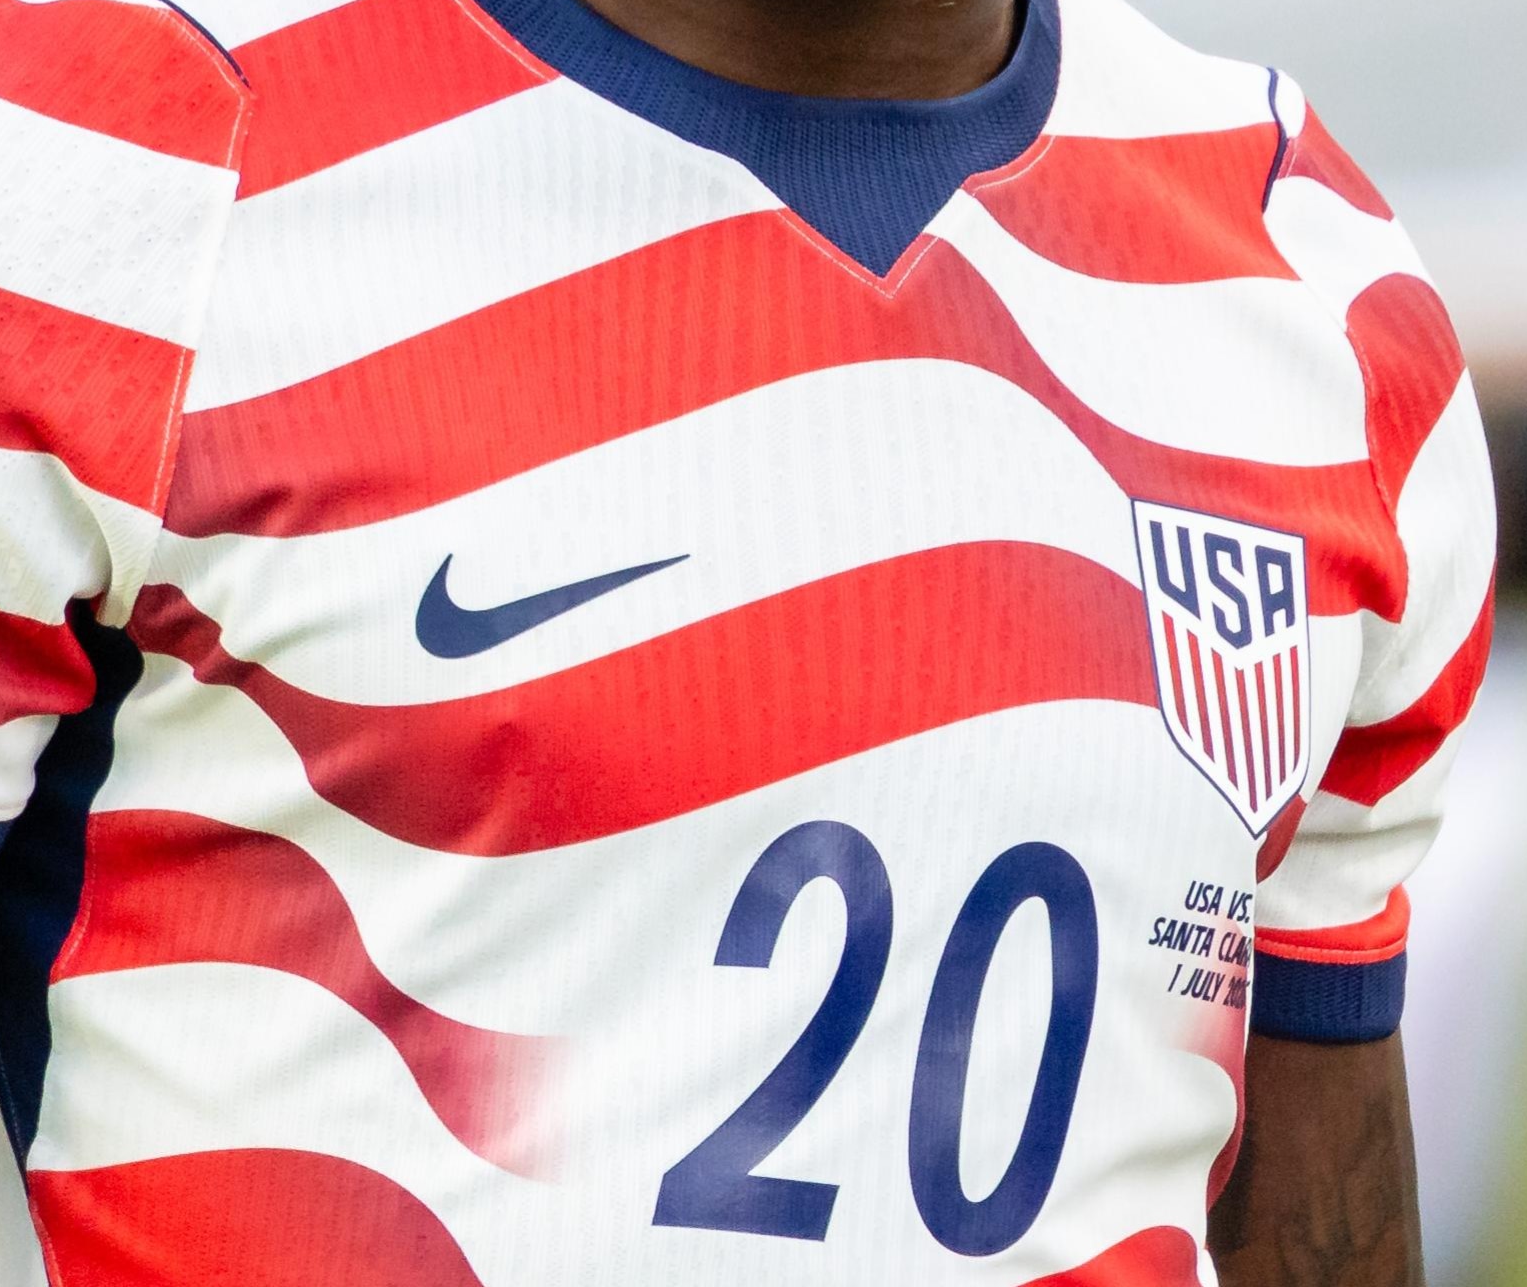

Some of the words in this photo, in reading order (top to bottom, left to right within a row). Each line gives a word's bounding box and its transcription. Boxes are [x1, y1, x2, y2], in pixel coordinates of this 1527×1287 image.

[1150, 521, 1295, 649] USA
[1184, 880, 1224, 916] USA
[1226, 890, 1253, 924] VS.
[1148, 917, 1216, 958] SANTA
[1218, 932, 1252, 968] CLA
[1167, 964, 1183, 993] 1
[1180, 968, 1226, 1003] JULY
[651, 820, 1099, 1257] 20
